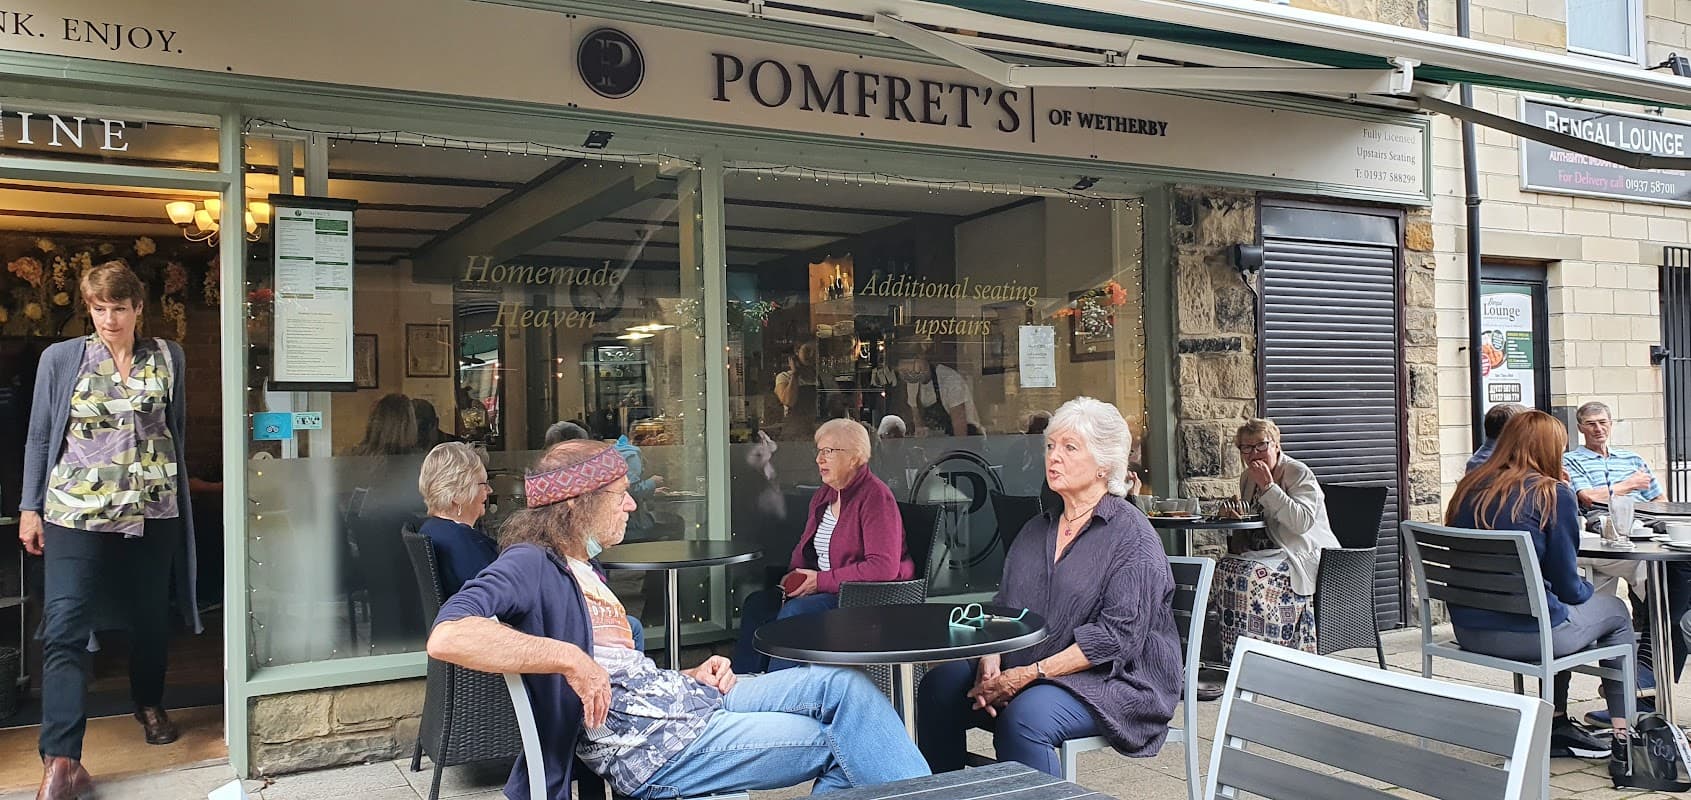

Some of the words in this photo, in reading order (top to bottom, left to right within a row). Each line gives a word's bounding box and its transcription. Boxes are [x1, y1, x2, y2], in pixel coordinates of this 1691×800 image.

[62, 18, 183, 54] ENJOY.
[711, 53, 1020, 133] POMFRET'S
[1049, 109, 1072, 127] OF
[1077, 111, 1168, 137] WETHERBY
[1363, 128, 1382, 142] Fully
[1385, 131, 1416, 144] Licensed
[1545, 110, 1616, 147] BENGAL
[1619, 121, 1684, 156] LOUNGE
[1356, 146, 1387, 160] Upstairs
[1389, 150, 1416, 165] Seating
[1355, 168, 1362, 178] T:
[1364, 169, 1387, 181] 01937
[1389, 172, 1416, 184] 588299
[1558, 169, 1572, 182] For
[1575, 172, 1608, 189] Delivery
[1610, 175, 1624, 188] call
[1625, 178, 1648, 192] 01937
[1650, 181, 1675, 195] 587011
[461, 255, 621, 287] Homemade
[859, 272, 968, 299] Additional
[973, 280, 1039, 307] seating
[491, 301, 597, 329] Heaven
[1483, 303, 1520, 322] Lounge
[915, 315, 992, 341] upstairs
